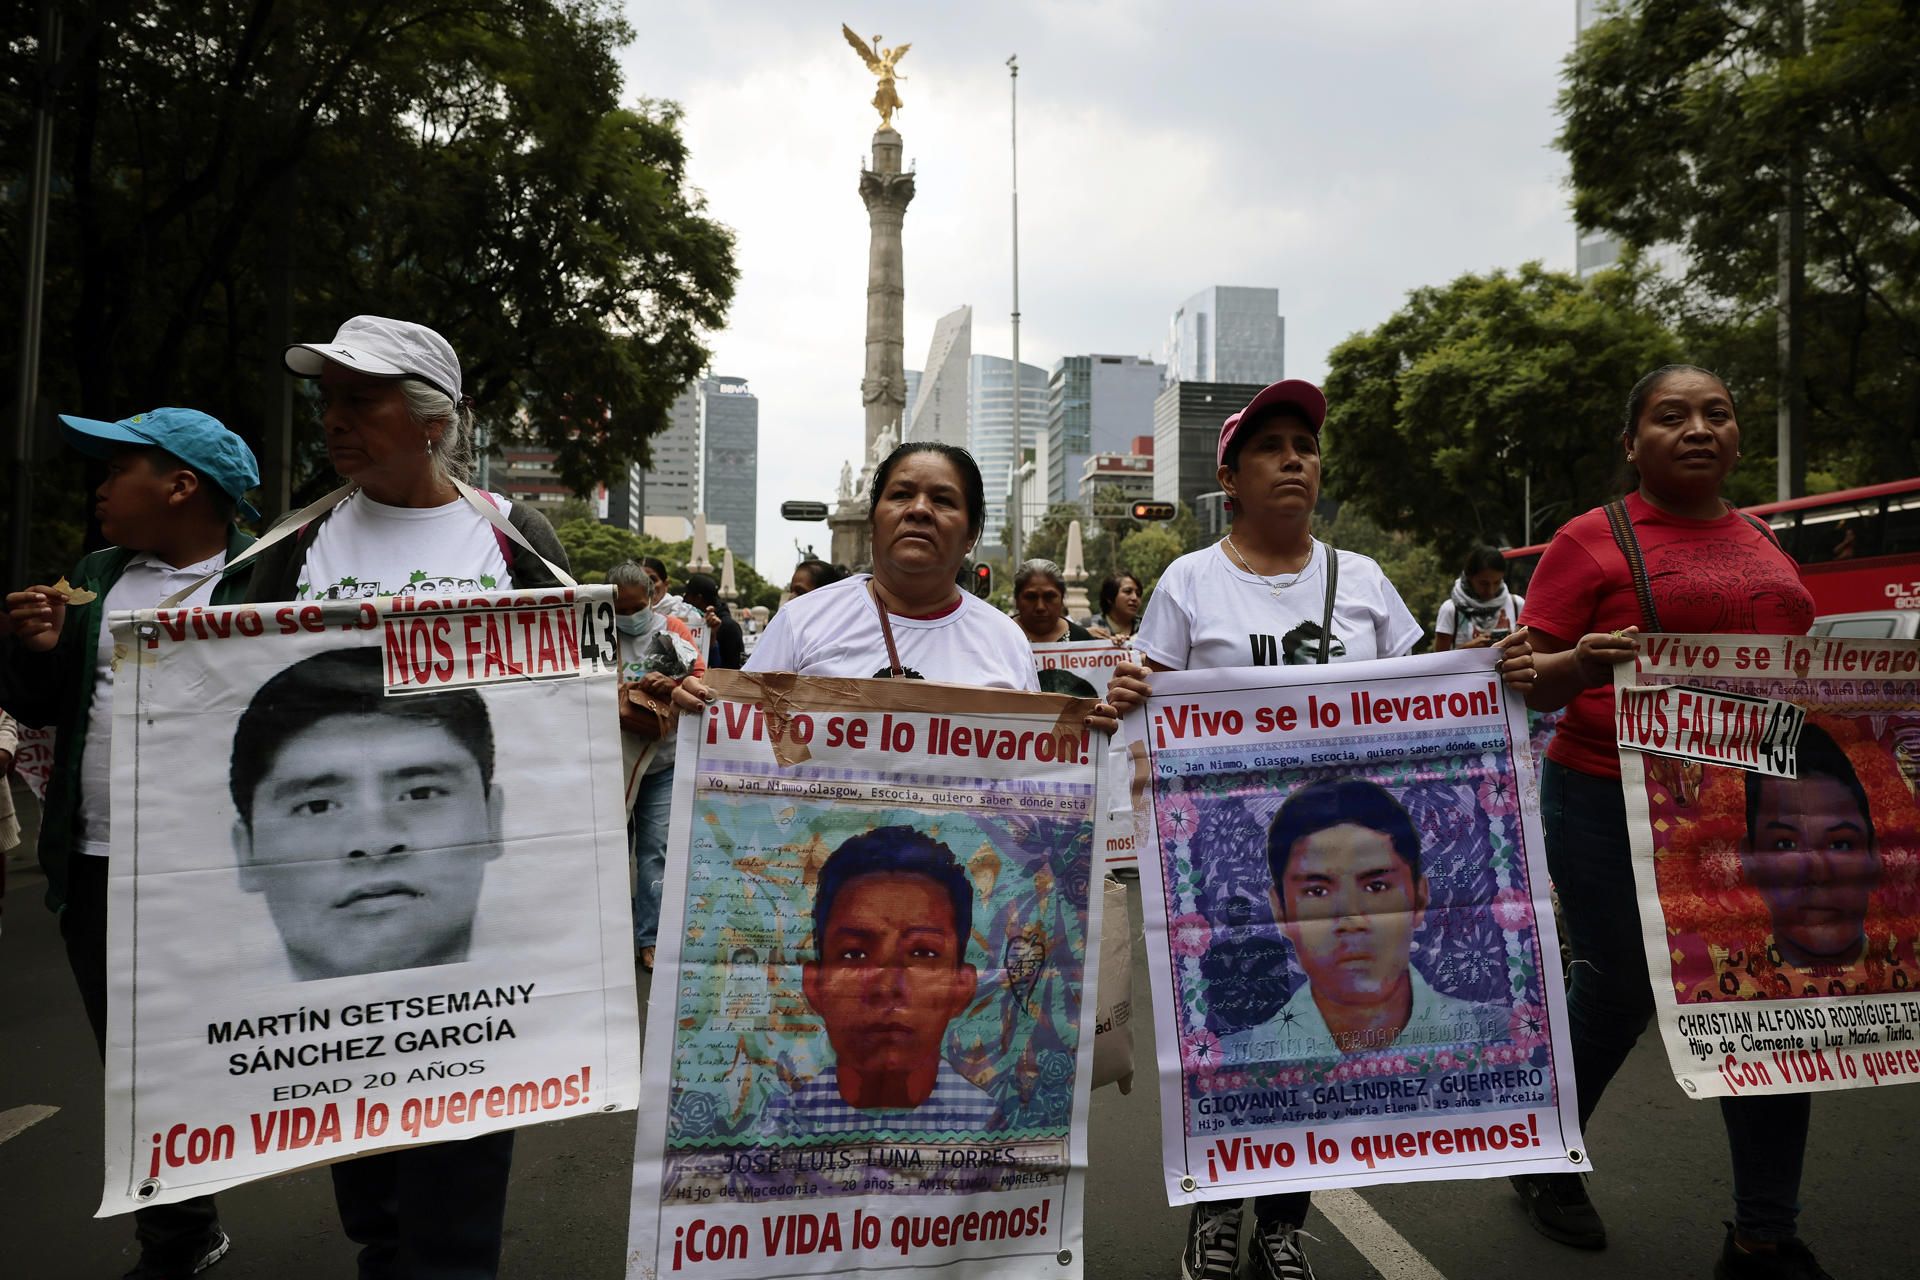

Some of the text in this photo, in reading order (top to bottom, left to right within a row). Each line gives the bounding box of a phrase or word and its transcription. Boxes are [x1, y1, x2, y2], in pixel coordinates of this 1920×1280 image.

[148, 607, 264, 648] Vivo
[280, 607, 323, 635] se
[342, 602, 378, 631] o
[384, 601, 618, 687] NOS FALTAN 43
[1043, 656, 1056, 670] lo
[1735, 647, 1771, 670] se
[1784, 641, 1811, 670] lo
[1824, 642, 1920, 673] llevaro
[705, 701, 1090, 765] ¡Vivo se lo llevaron!
[1155, 681, 1500, 749] ¡Vivo se lo llevaron!
[1619, 688, 1670, 748] NOS
[1675, 693, 1768, 763] FALTAN
[1158, 737, 1506, 776] Yo, Jan Nimmo, Glasgow, Escocia, quiero saber dónde está
[708, 776, 728, 790] Yo,
[738, 778, 760, 791] Jan
[871, 788, 924, 802] Escocia,
[932, 792, 974, 806] quiero
[979, 793, 1014, 806] saber
[1019, 794, 1055, 808] dónde
[1060, 797, 1087, 810] está
[207, 983, 536, 1044] MARTÍN GETSEMANY
[1678, 1012, 1751, 1037] CHRISTIAN
[1757, 1007, 1827, 1032] ALFONSO
[1831, 1000, 1901, 1028] RODRÍGUEZ
[228, 1016, 517, 1077] SÁNCHEZ GARCÍA
[1689, 1037, 1714, 1061] Hijo
[1719, 1037, 1736, 1053] de
[1740, 1032, 1804, 1052] Clemente
[1811, 1035, 1819, 1051] y
[1825, 1029, 1844, 1047] Luz
[273, 1059, 486, 1102] EDAD 20 AÑOS
[1198, 1068, 1543, 1115] GIOVANNI GALINDREZ GUERRERO
[1718, 1046, 1920, 1095] ¡Con VIDA lo quere
[149, 1066, 591, 1178] ¡Con VIDA lo queremos!
[1198, 1119, 1225, 1131] Hijo
[1230, 1116, 1245, 1126] de
[1250, 1113, 1276, 1124] José
[1282, 1110, 1328, 1122] Alfredo
[1333, 1111, 1341, 1121] y
[1384, 1103, 1417, 1114] Elena
[1436, 1100, 1449, 1109] 19
[1455, 1097, 1481, 1108] años
[1498, 1092, 1545, 1104] Arcelia
[866, 1147, 922, 1170] LUNA
[938, 1147, 1017, 1170] TORRES
[1207, 1113, 1542, 1182] ¡Vivo lo queremos!
[676, 1184, 711, 1200] Hijo
[718, 1184, 737, 1198] de
[742, 1182, 818, 1198] Macedonia
[841, 1179, 858, 1192] 20
[863, 1176, 895, 1191] años
[1000, 1172, 1049, 1187] MORELOS
[672, 1199, 1050, 1271] ¡Con VIDA lo queremos!
